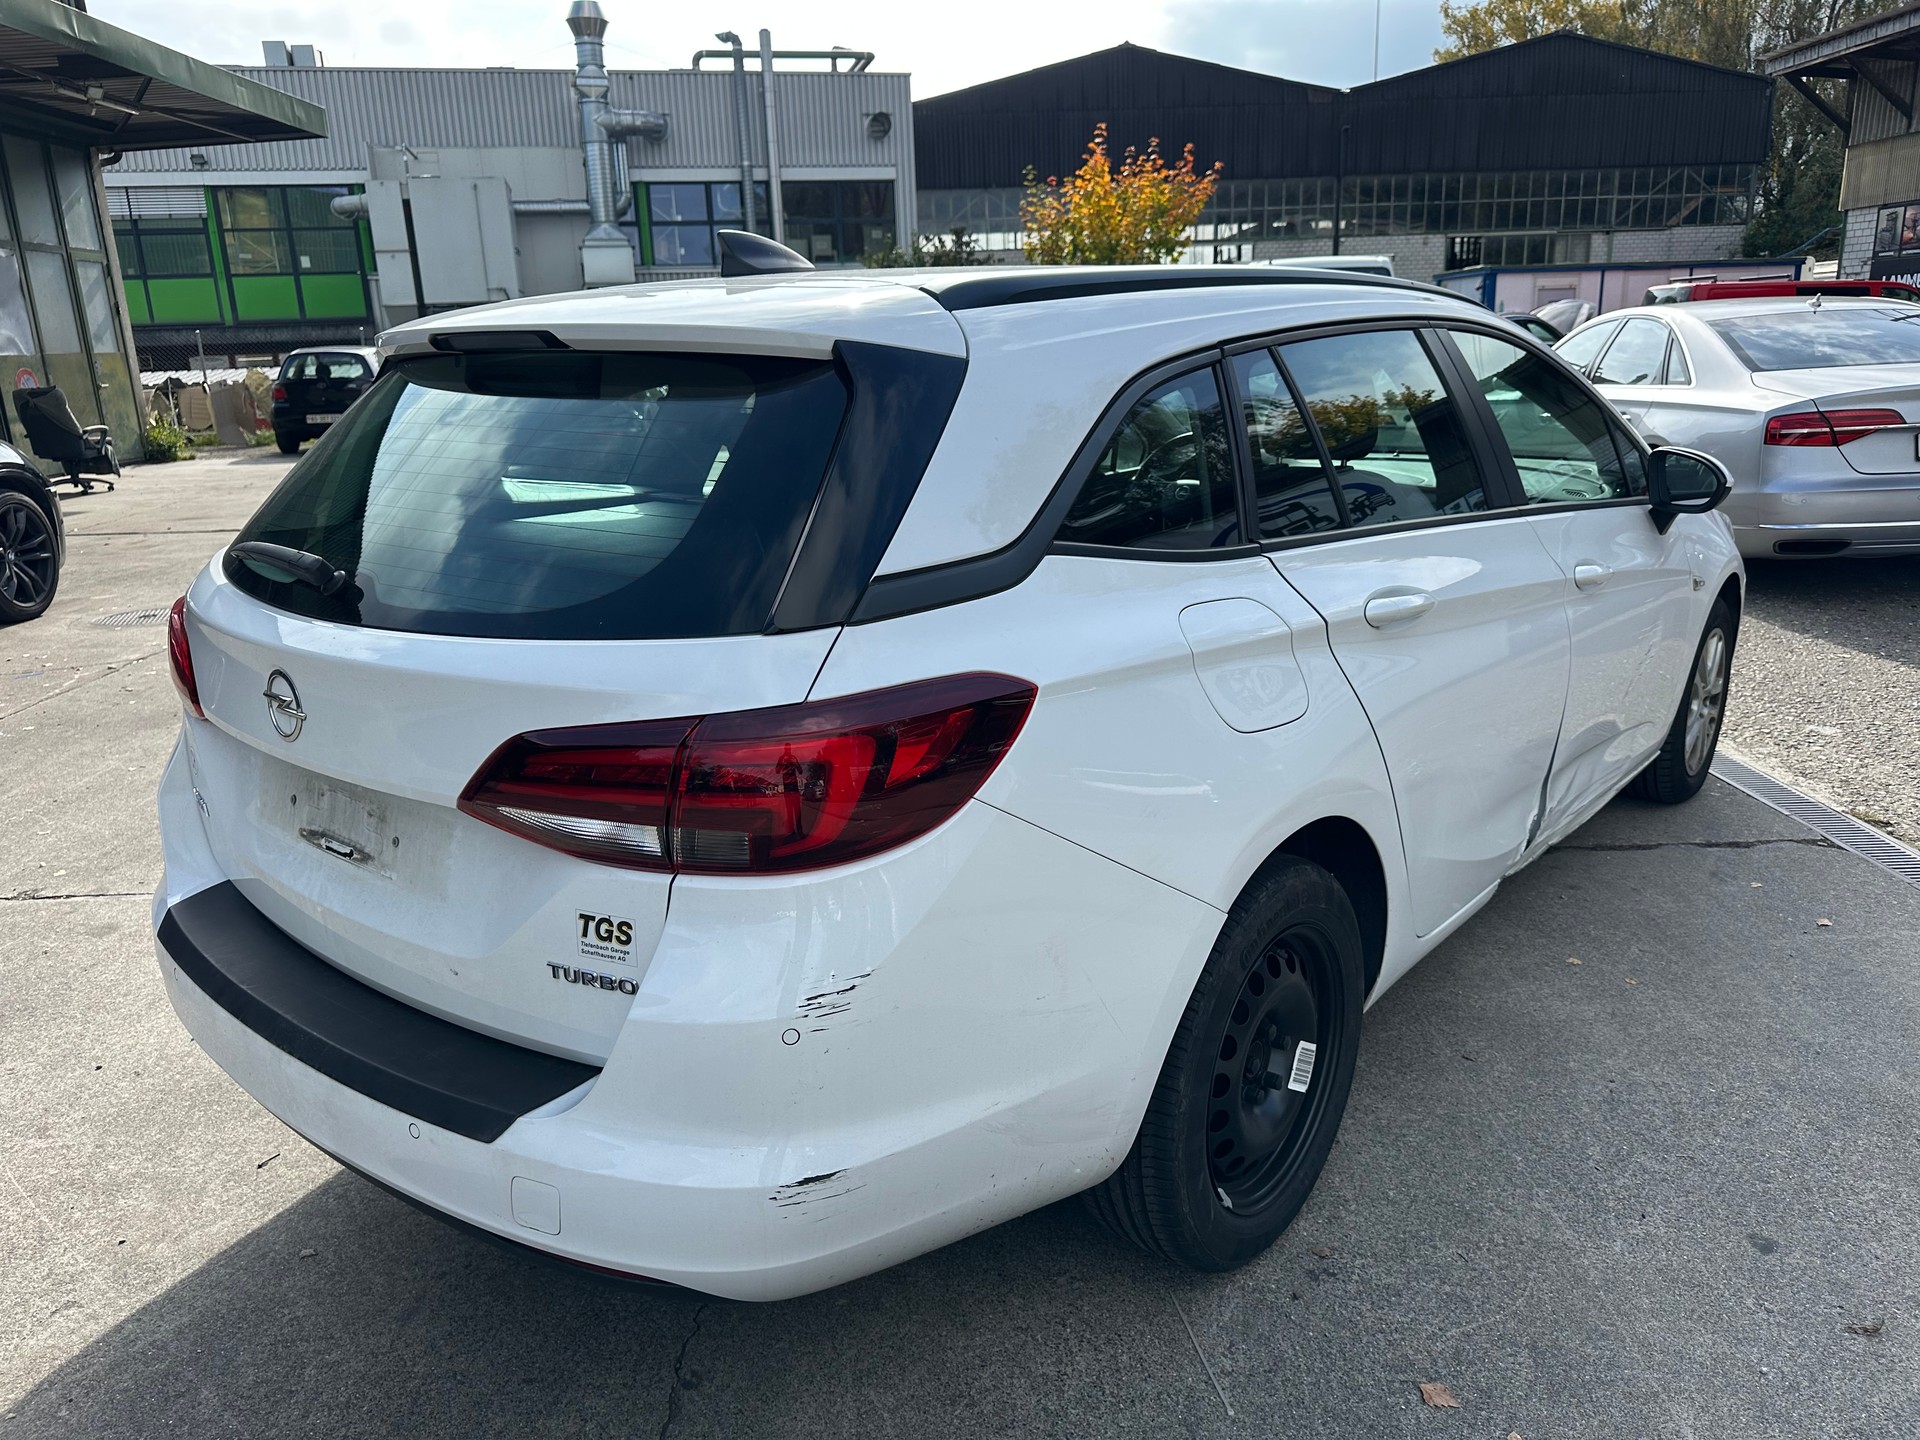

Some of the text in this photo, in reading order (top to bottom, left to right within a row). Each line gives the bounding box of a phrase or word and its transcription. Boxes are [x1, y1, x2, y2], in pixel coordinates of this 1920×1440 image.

[578, 912, 633, 946] TGS
[610, 947, 631, 956] Garage
[546, 961, 639, 995] TURBO
